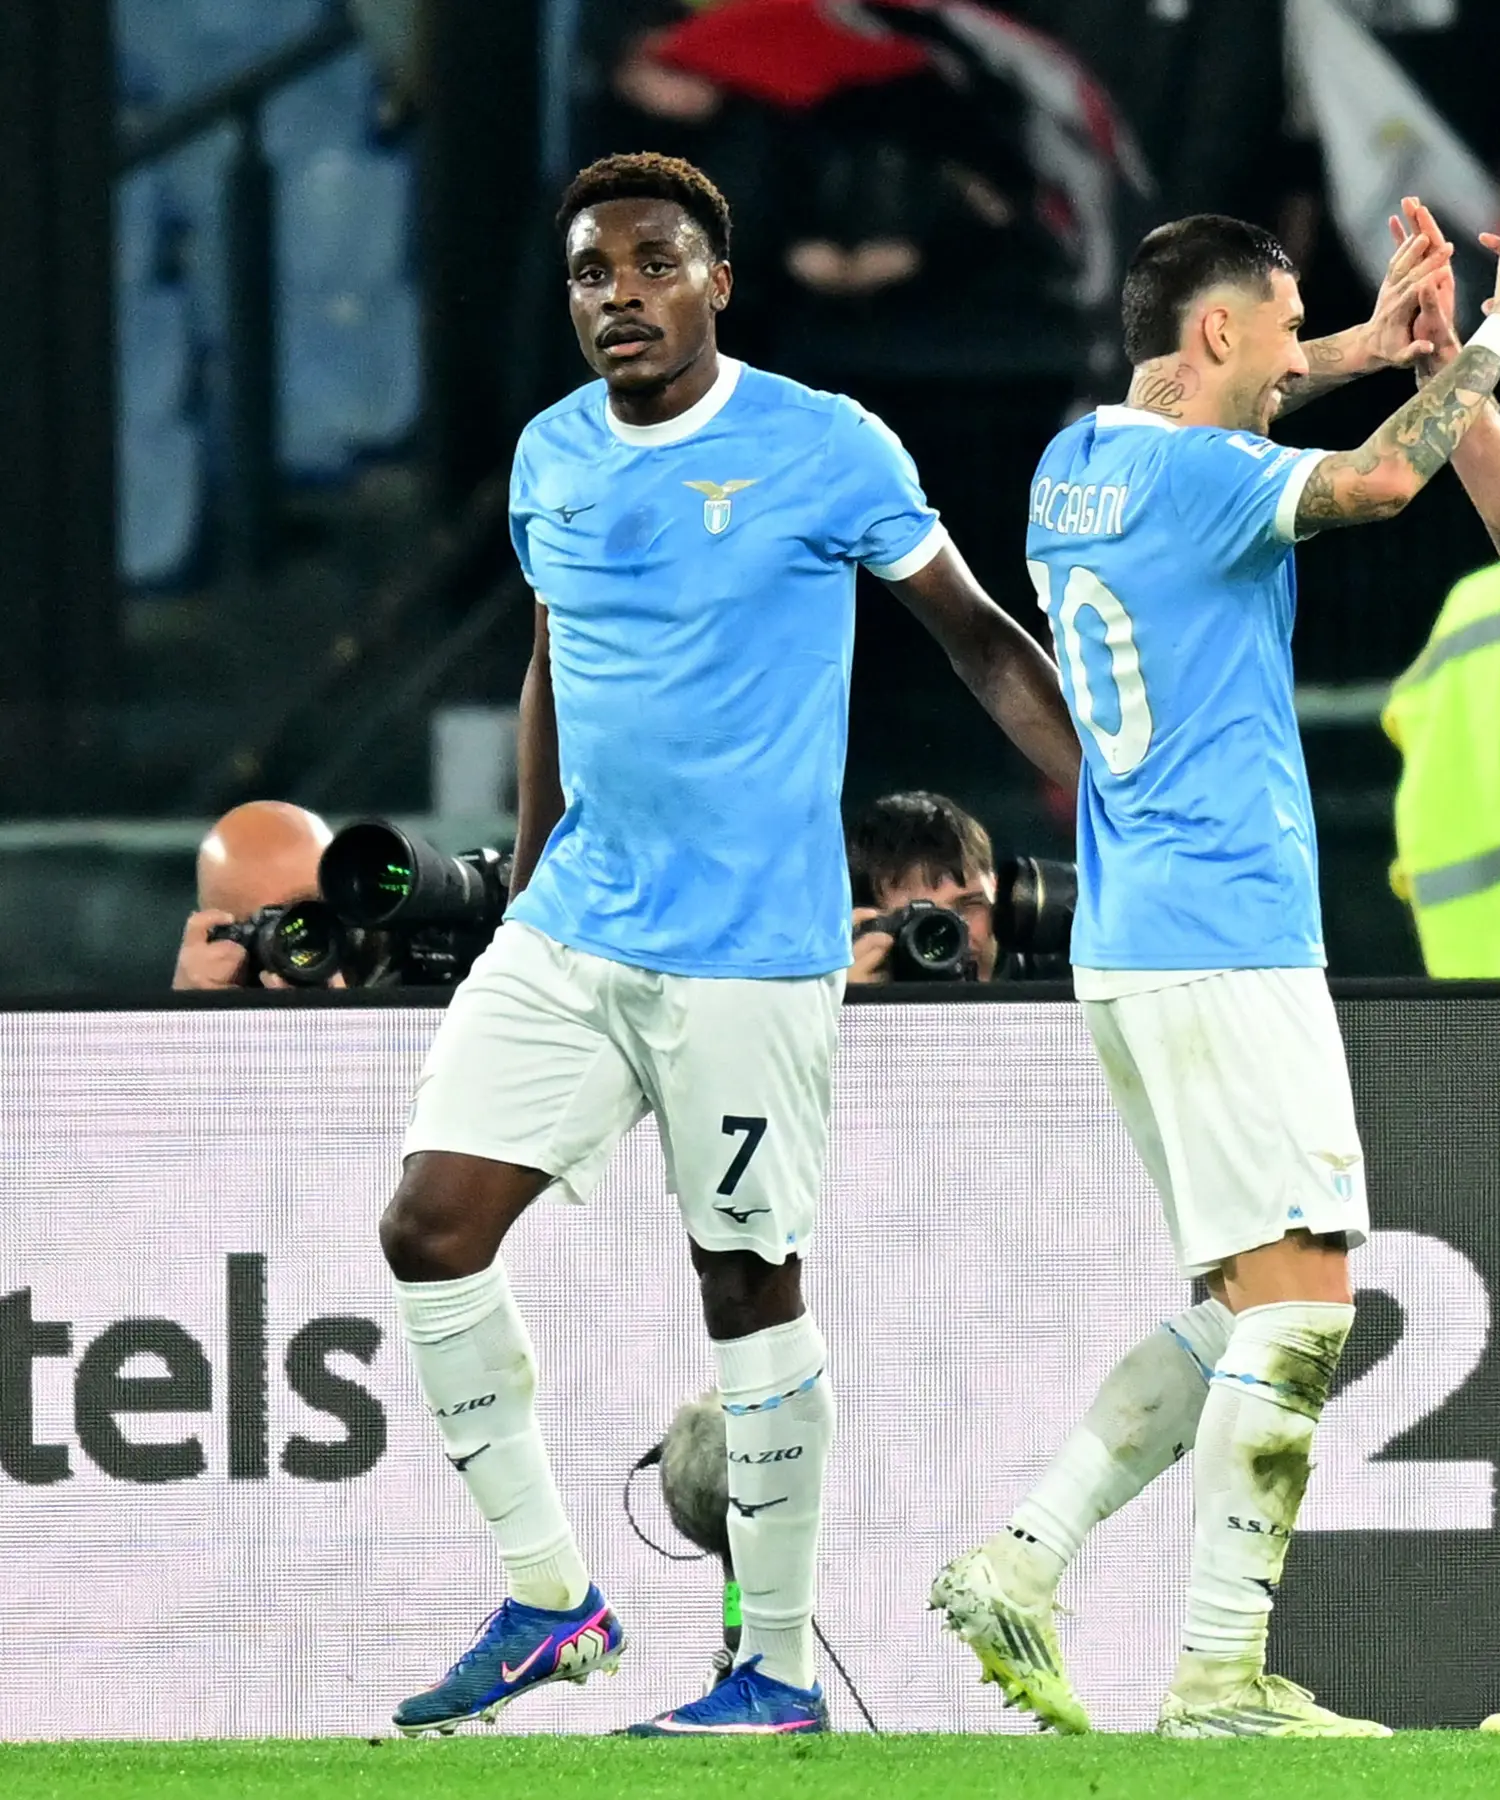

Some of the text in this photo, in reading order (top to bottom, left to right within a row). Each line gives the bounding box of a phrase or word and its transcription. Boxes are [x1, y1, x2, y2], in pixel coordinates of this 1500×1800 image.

[1029, 476, 1129, 535] ACCAGNI
[716, 1115, 767, 1195] 7
[0, 1252, 388, 1484] tels
